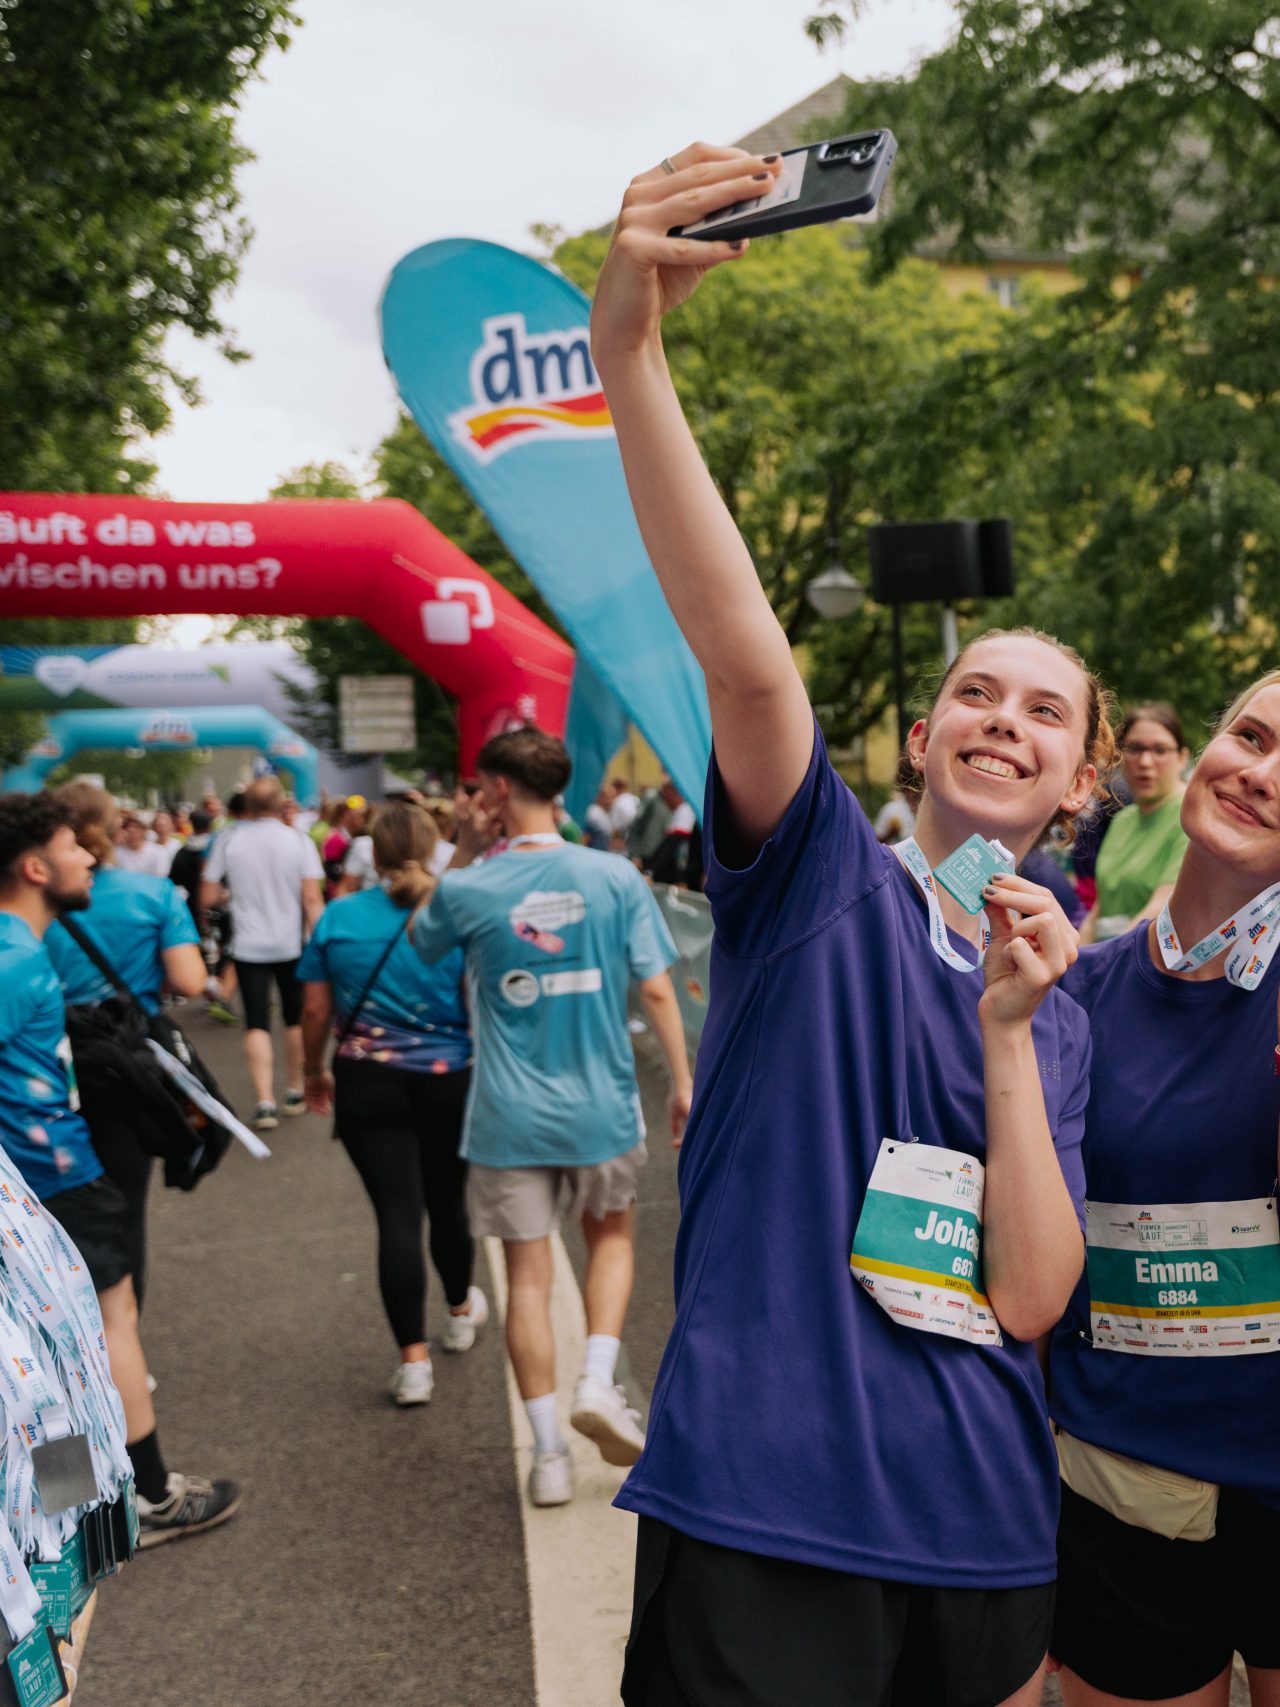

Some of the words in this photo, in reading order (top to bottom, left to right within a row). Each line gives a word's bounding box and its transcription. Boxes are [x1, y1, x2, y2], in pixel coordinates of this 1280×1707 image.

[481, 326, 595, 403] dm
[96, 513, 156, 546] da
[164, 520, 256, 547] was
[177, 557, 283, 590] uns?
[953, 861, 976, 881] LAUF
[1224, 926, 1237, 939] dm
[1248, 922, 1262, 939] dm
[1164, 937, 1173, 950] dm
[1253, 960, 1264, 975] dm
[962, 1161, 972, 1169] dm
[956, 1186, 974, 1198] LAUF
[1139, 1210, 1151, 1218] dm
[1140, 1231, 1161, 1241] LAUF
[1135, 1257, 1219, 1284] Emma
[860, 1275, 874, 1286] dm
[1158, 1289, 1198, 1306] 6884
[20, 1357, 34, 1373] dm
[26, 1423, 37, 1441] dm
[25, 1676, 43, 1698] LAUF
